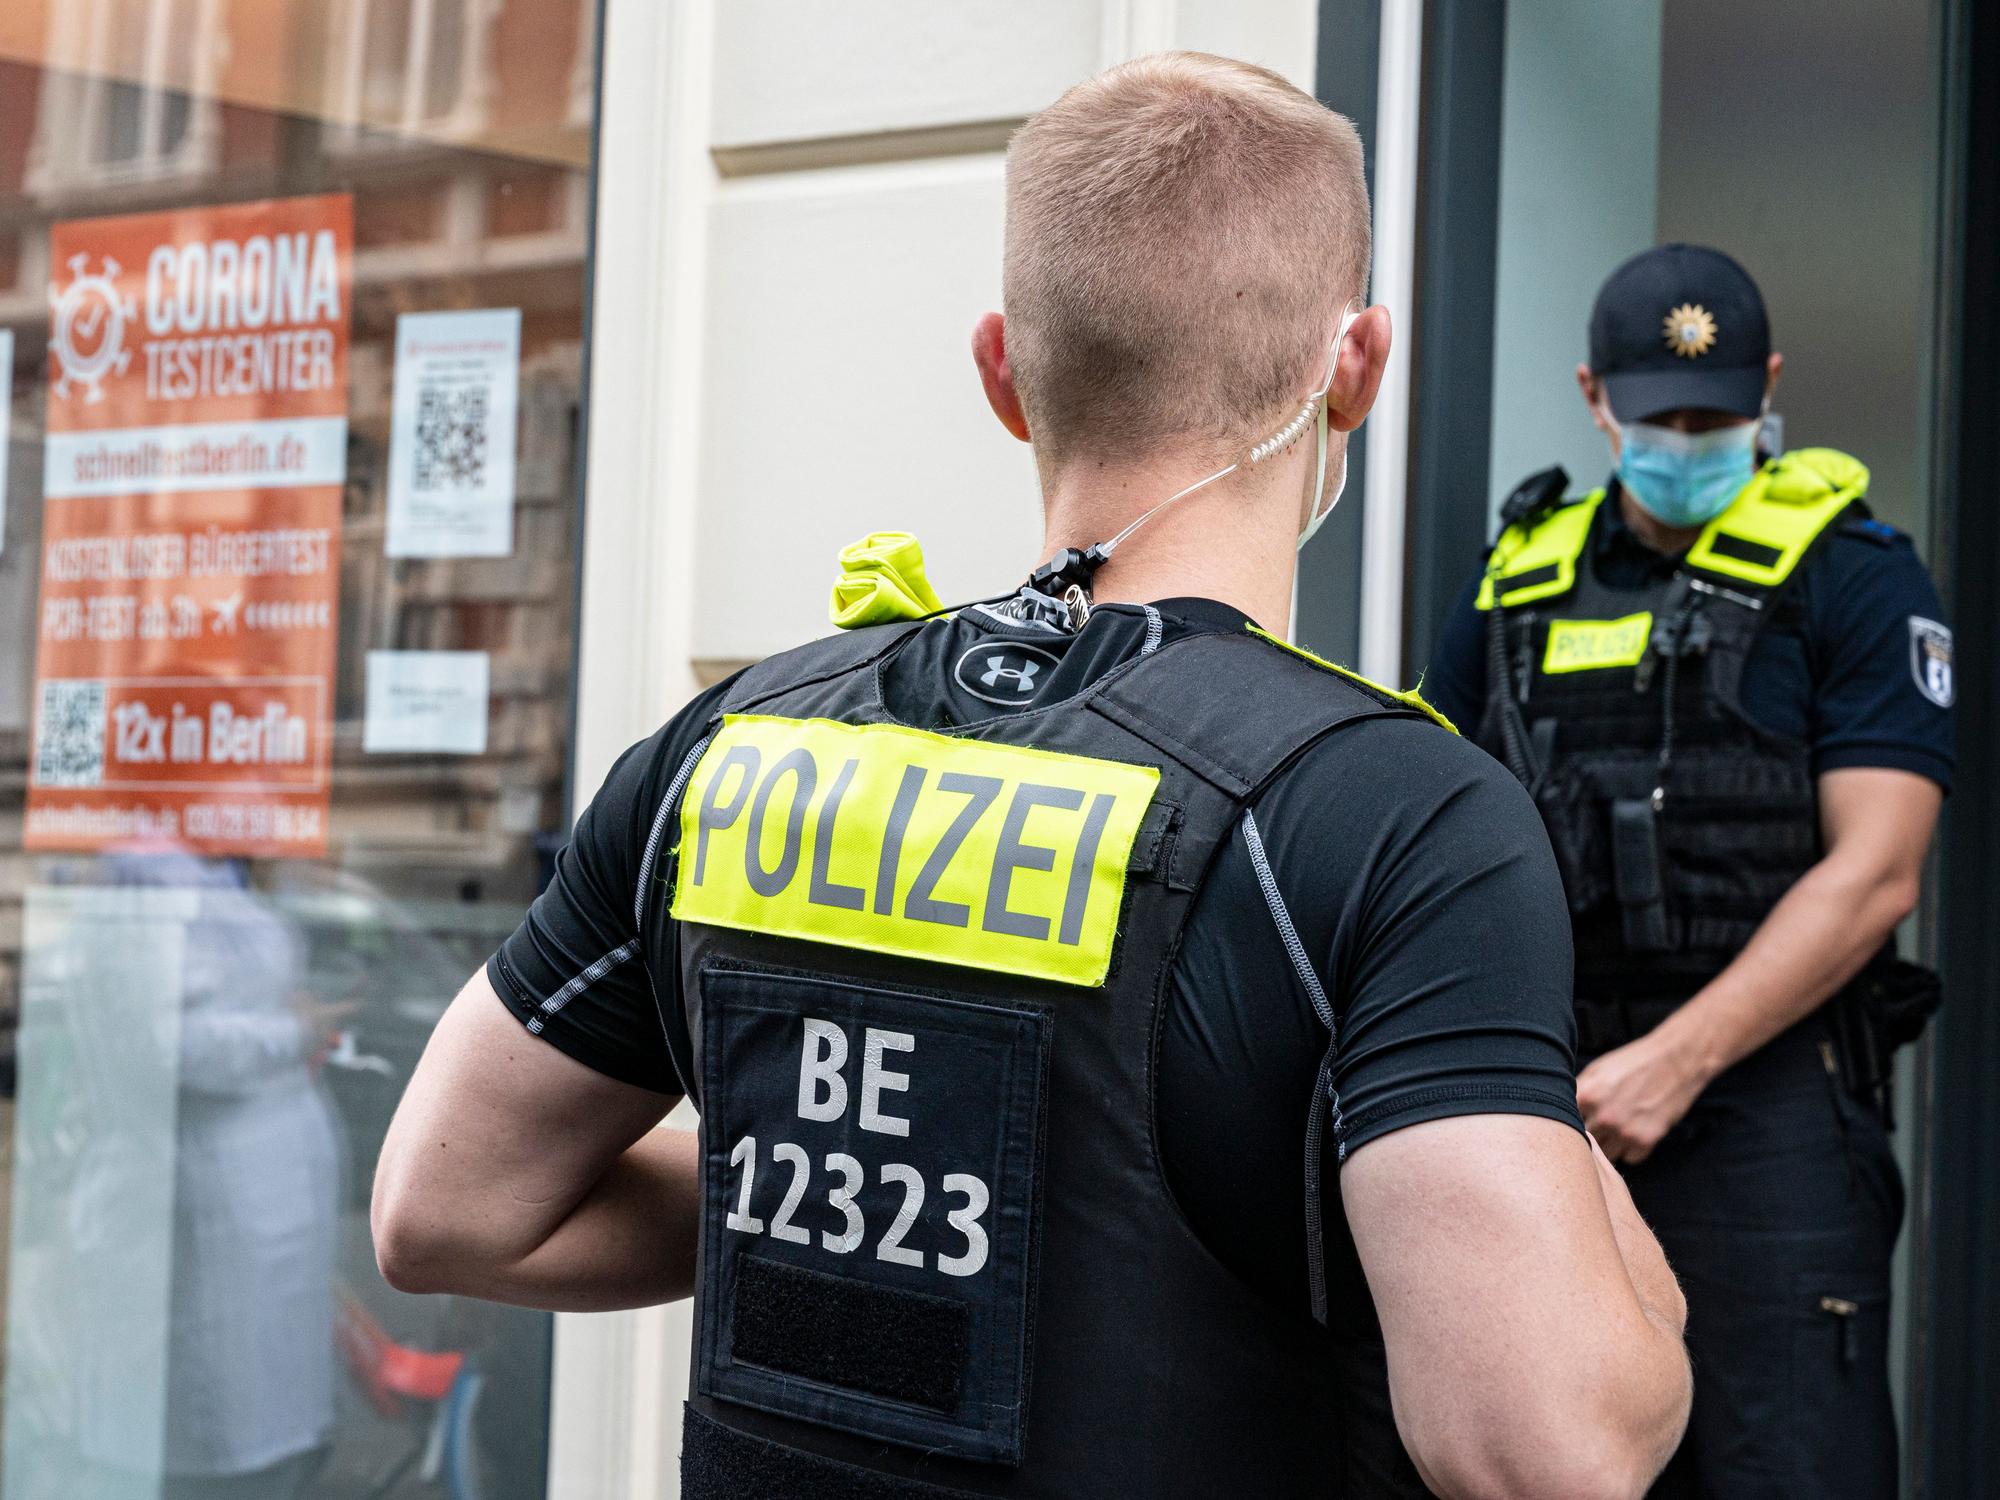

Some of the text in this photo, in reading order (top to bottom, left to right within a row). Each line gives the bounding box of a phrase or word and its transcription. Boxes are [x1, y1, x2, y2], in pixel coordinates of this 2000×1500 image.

[146, 230, 340, 336] CORONA
[144, 330, 336, 401] TESTCENTER
[114, 701, 307, 764] 12x in Berlin
[693, 745, 1117, 946] POLIZEI
[798, 1017, 915, 1137] BE
[727, 1135, 990, 1277] 12323
